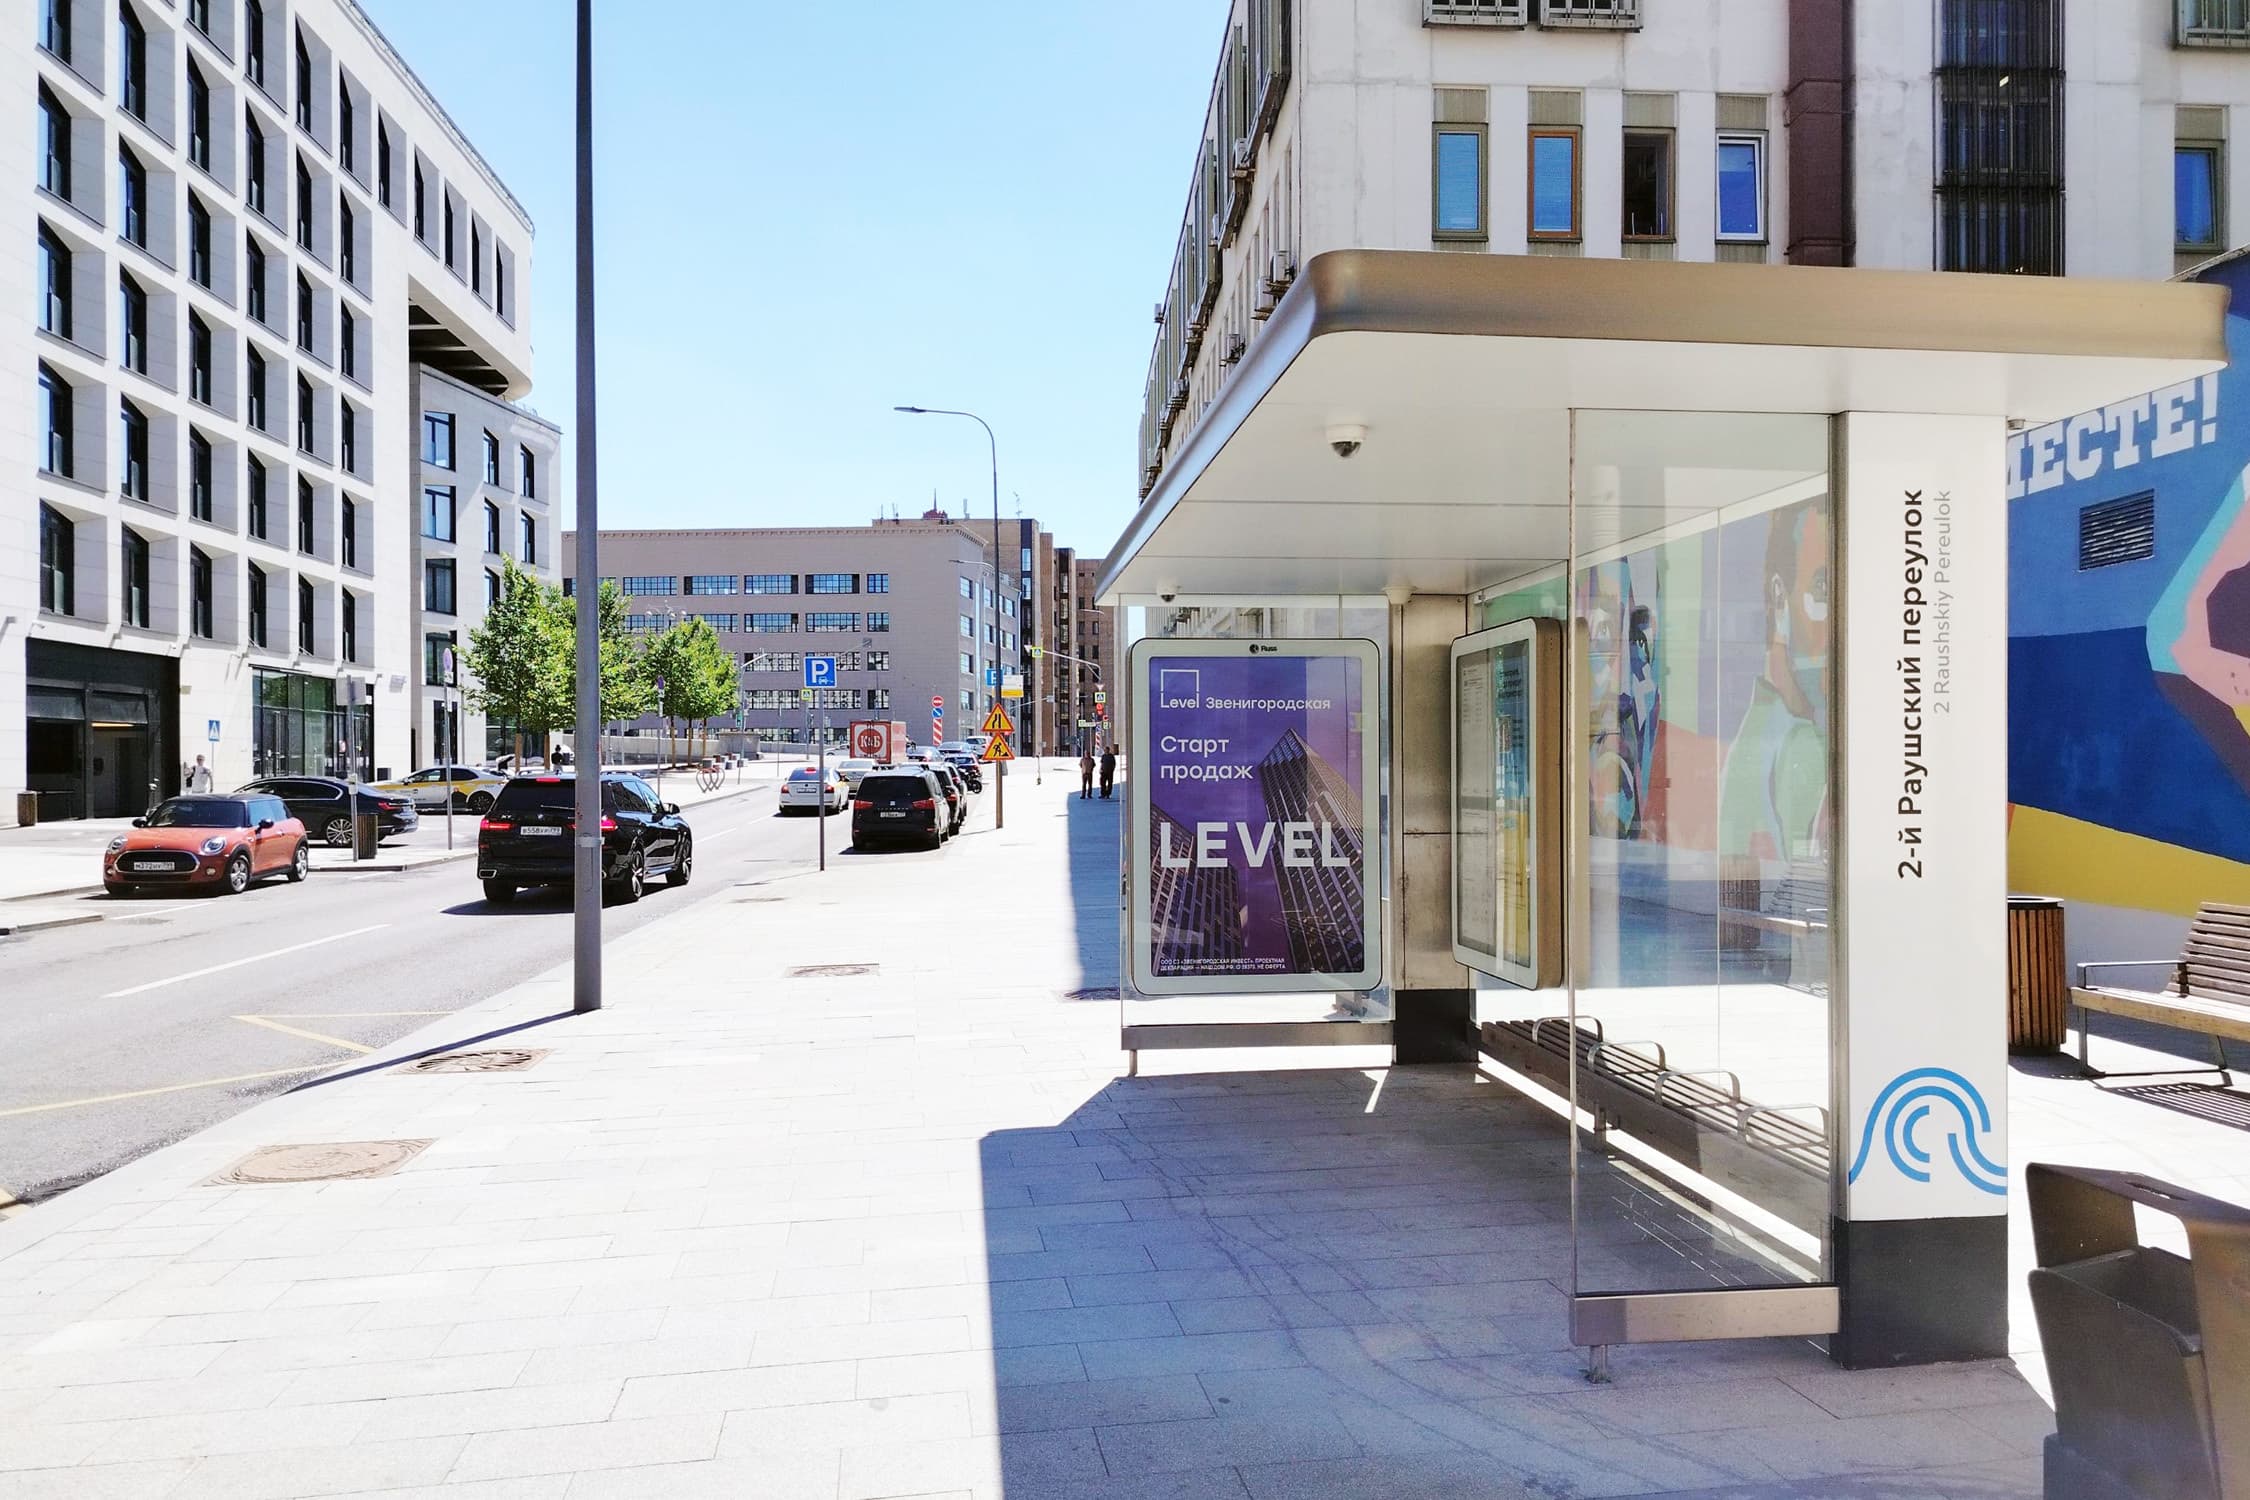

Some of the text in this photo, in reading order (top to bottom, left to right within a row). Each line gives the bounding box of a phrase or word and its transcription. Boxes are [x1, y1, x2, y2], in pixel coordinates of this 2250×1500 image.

[1932, 490, 1954, 714] 2 Raushskiy Pereulok
[811, 660, 829, 683] P
[1897, 489, 1928, 879] 2-й Раушский переулок
[1160, 692, 1331, 712] Level Звенигородская
[1160, 735, 1230, 758] Старт
[1160, 765, 1254, 784] продаж
[1160, 821, 1351, 868] LEVEL
